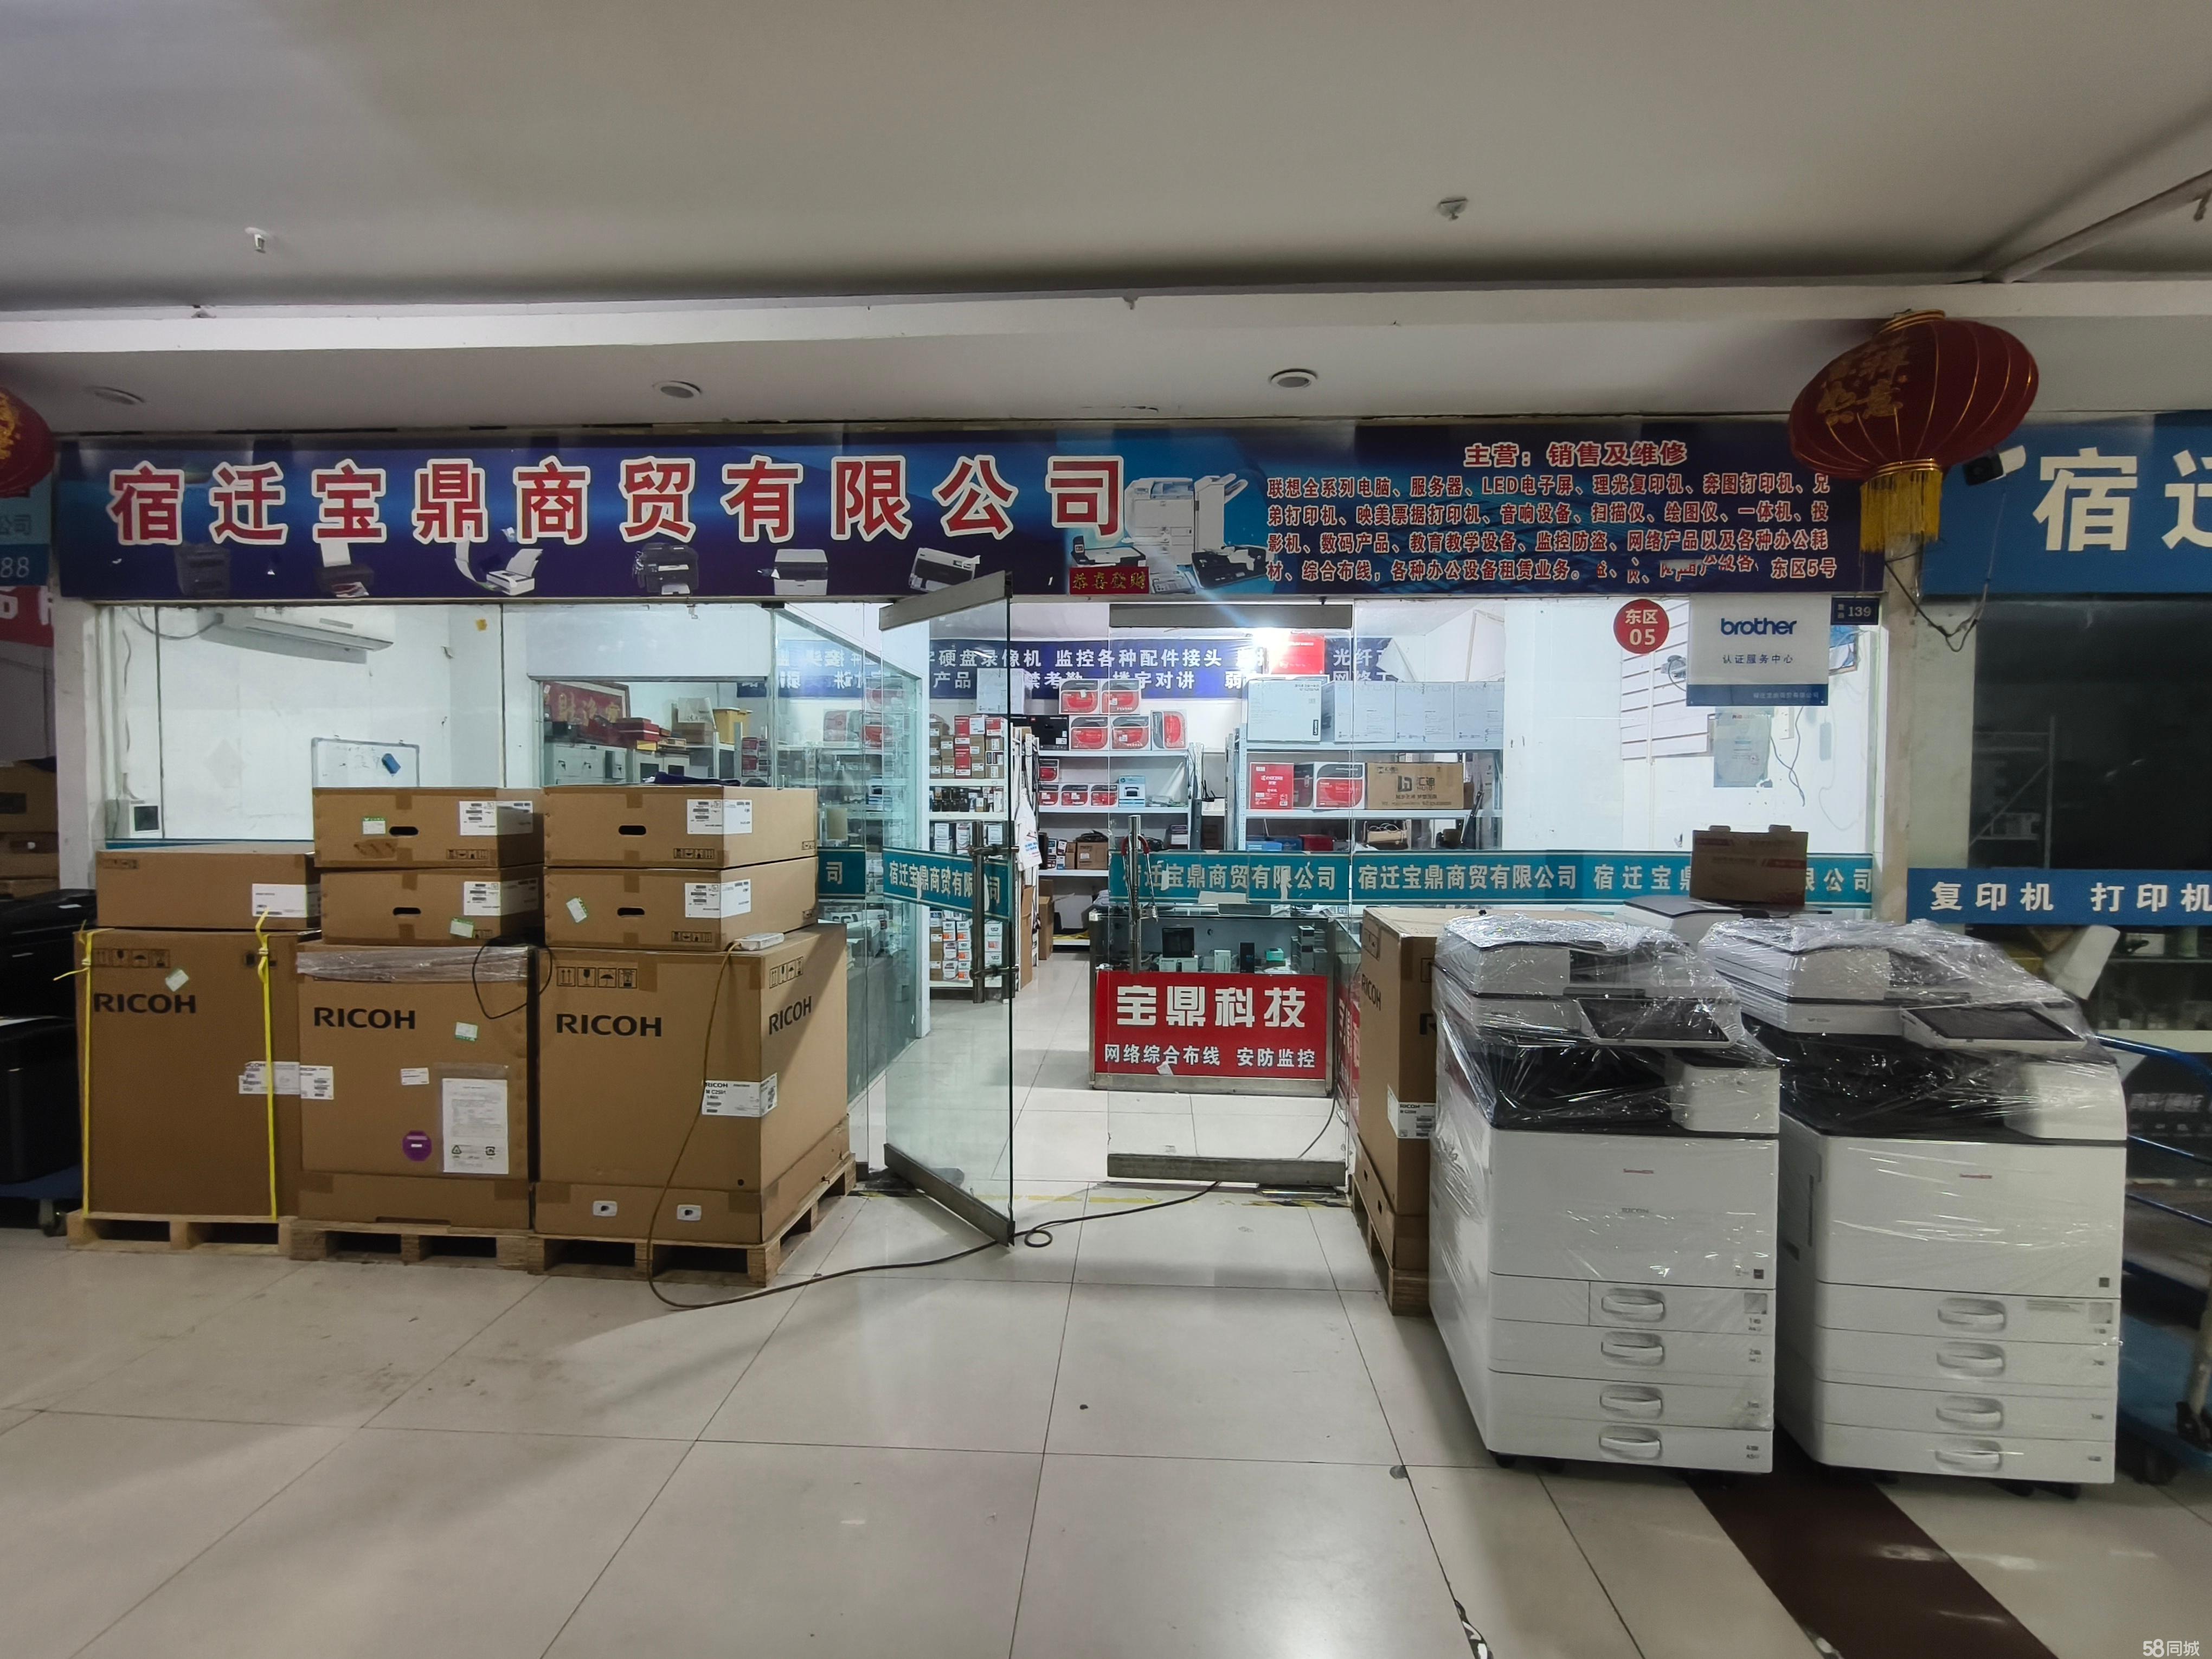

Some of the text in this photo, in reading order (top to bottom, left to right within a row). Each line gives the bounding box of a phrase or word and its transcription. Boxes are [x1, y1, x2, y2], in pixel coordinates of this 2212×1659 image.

[1464, 440, 1688, 468] 主营：销售及维修
[106, 454, 1124, 546] 宿迁宝鼎商贸有限公司
[1771, 557, 1837, 579] 东区5号
[1625, 608, 1658, 625] 东区
[1848, 606, 1872, 617] 139
[1629, 628, 1656, 646] 05
[1720, 618, 1797, 635] brother
[1055, 648, 1223, 668] 监控各种配件接头
[1722, 654, 1794, 664] 认证服务中心
[933, 671, 972, 689] 产品
[889, 860, 1001, 905] 宿迁宝鼎商贸有限司
[1358, 864, 1577, 890] 宿迁宝鼎商贸有限公司
[1930, 881, 2212, 912] 复印机 打印机
[94, 993, 197, 1014] RICOH
[1361, 973, 1382, 1012] RICOH
[768, 995, 812, 1036] RICOH
[1116, 985, 1306, 1028] 宝鼎科技
[314, 1007, 416, 1030] RICOH
[556, 1013, 663, 1037] RICOH
[1104, 1044, 1316, 1068] 网络综合布线 安防监控
